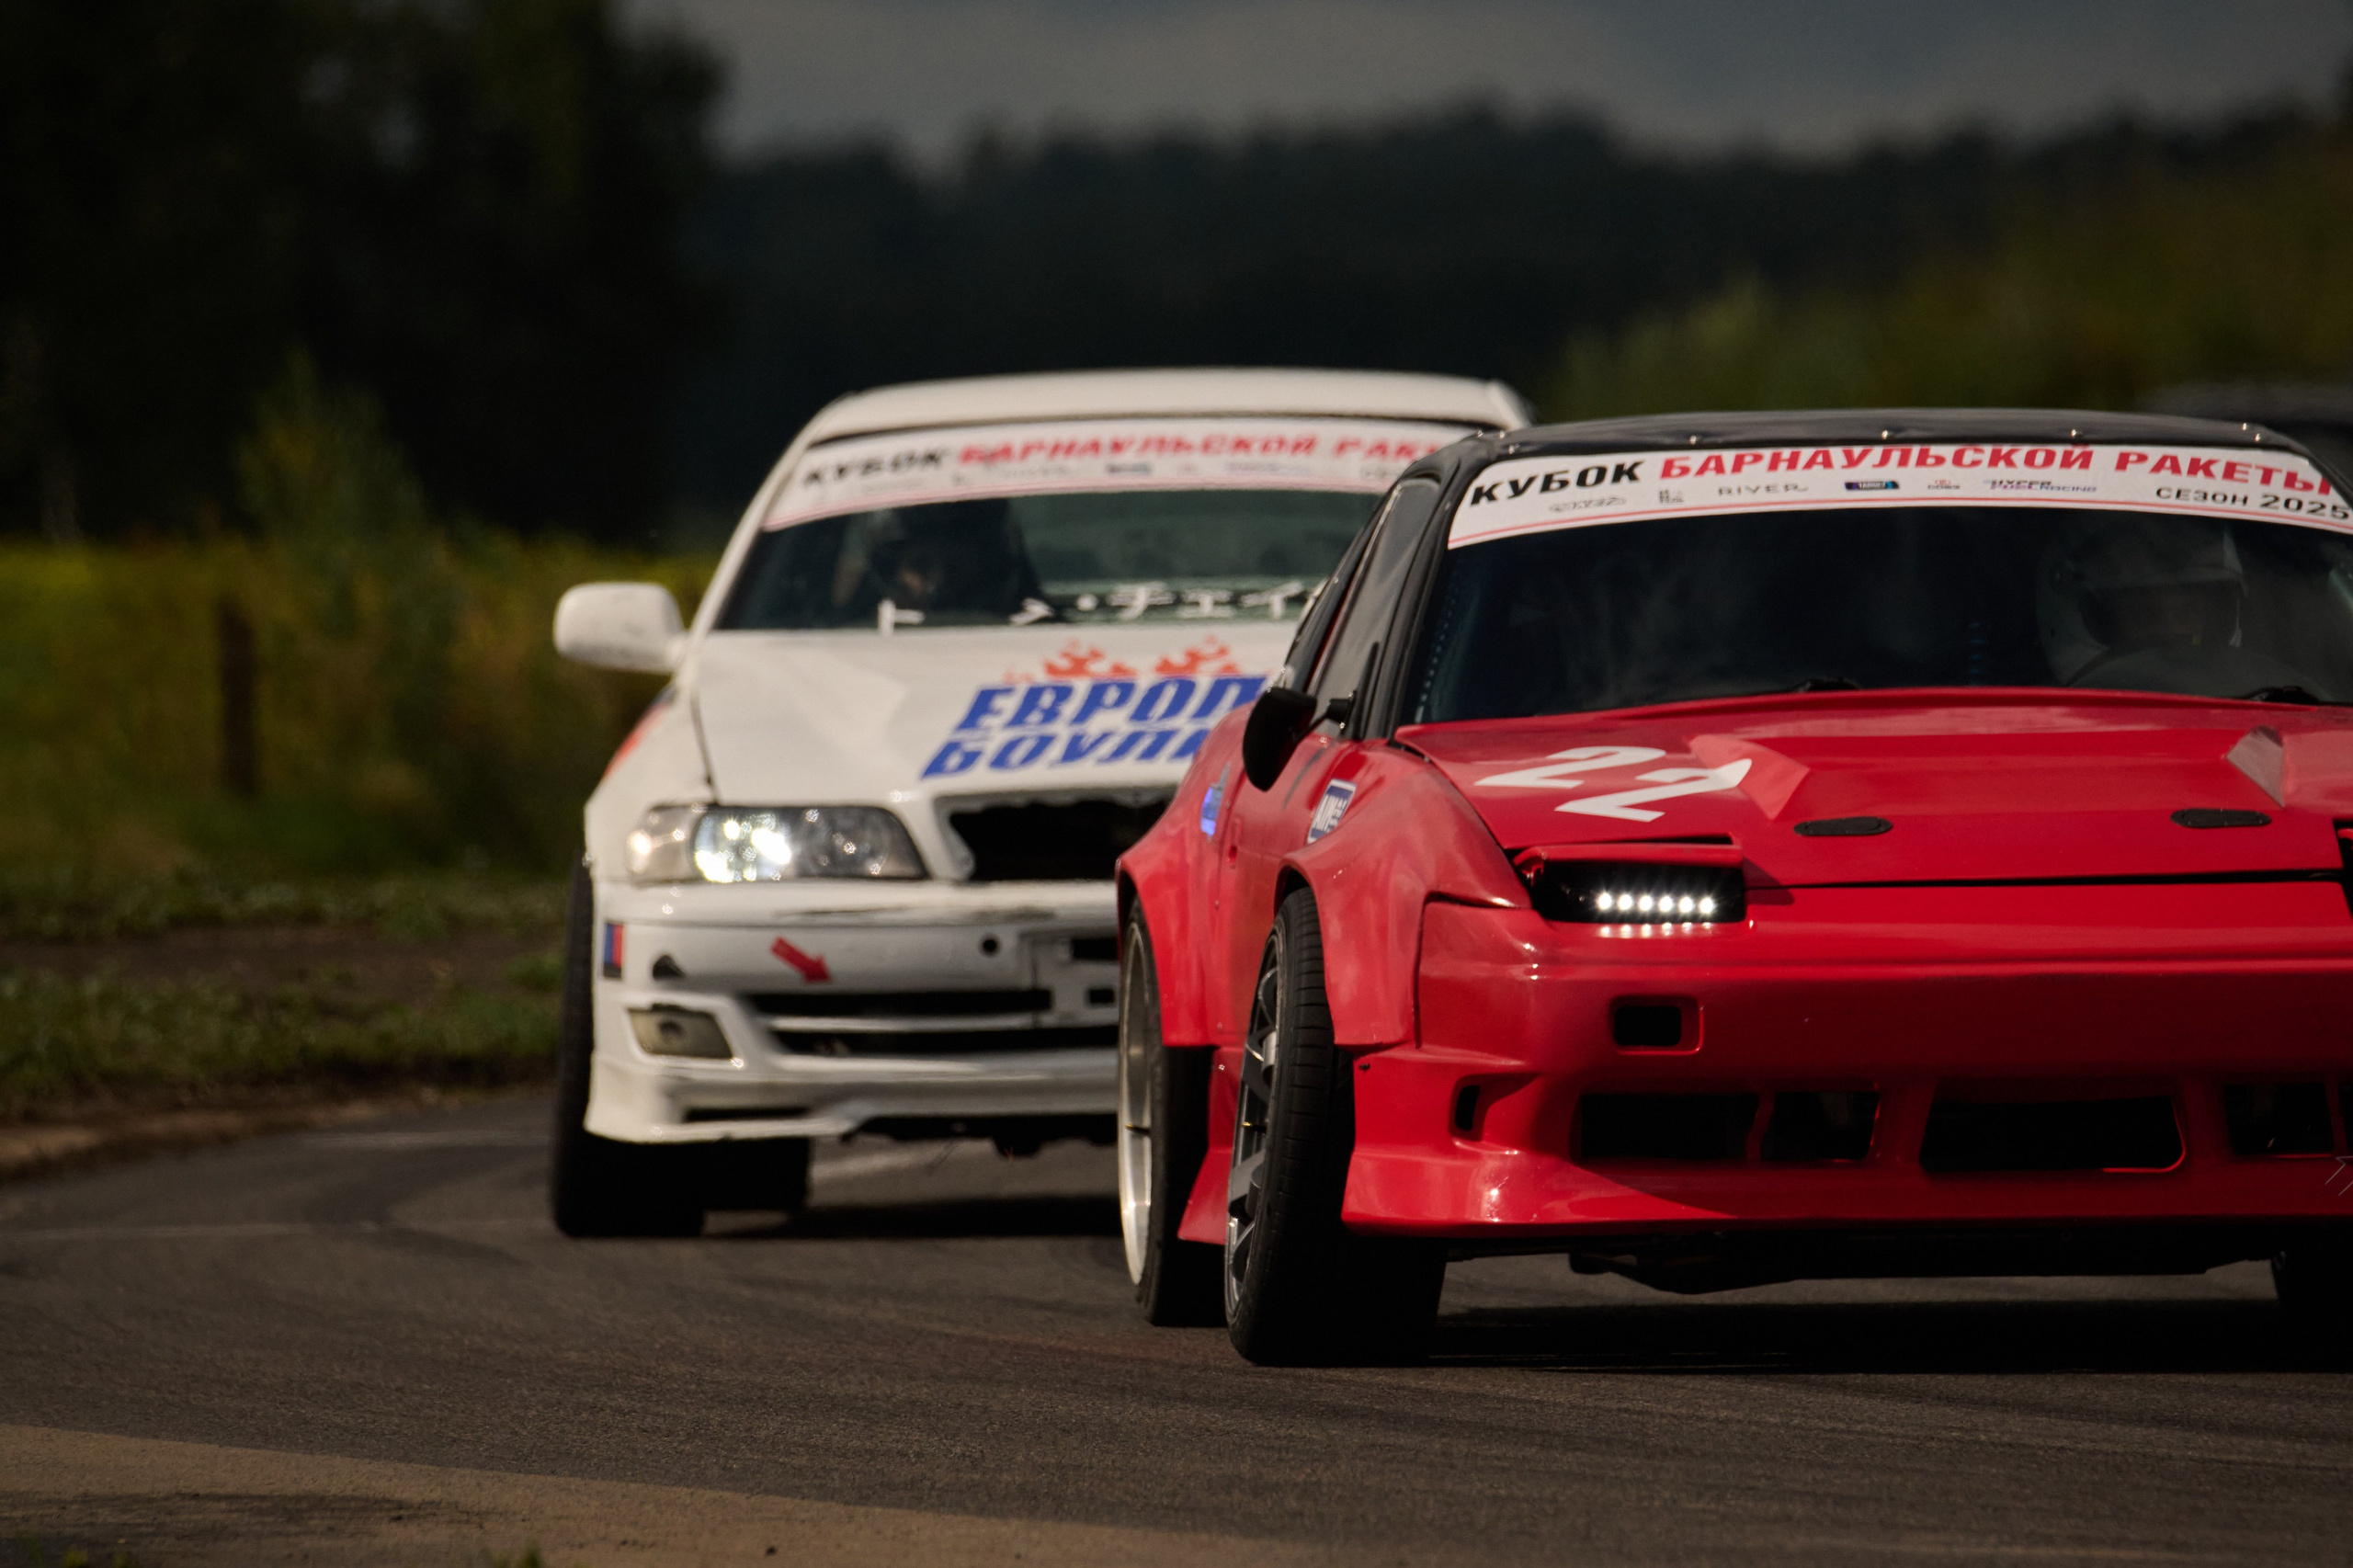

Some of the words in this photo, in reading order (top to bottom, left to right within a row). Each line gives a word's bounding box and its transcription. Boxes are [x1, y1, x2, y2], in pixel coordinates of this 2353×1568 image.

[1470, 460, 1644, 508] КУБОК
[1659, 444, 2095, 480] БАРНАУЛЬСКОЙ
[2113, 451, 2332, 497] РАКЕТЫ
[2154, 486, 2250, 507] СЕЗОН
[2258, 493, 2350, 521] 2025
[952, 676, 1267, 732] ЕВРОП
[1473, 745, 1753, 823] 22
